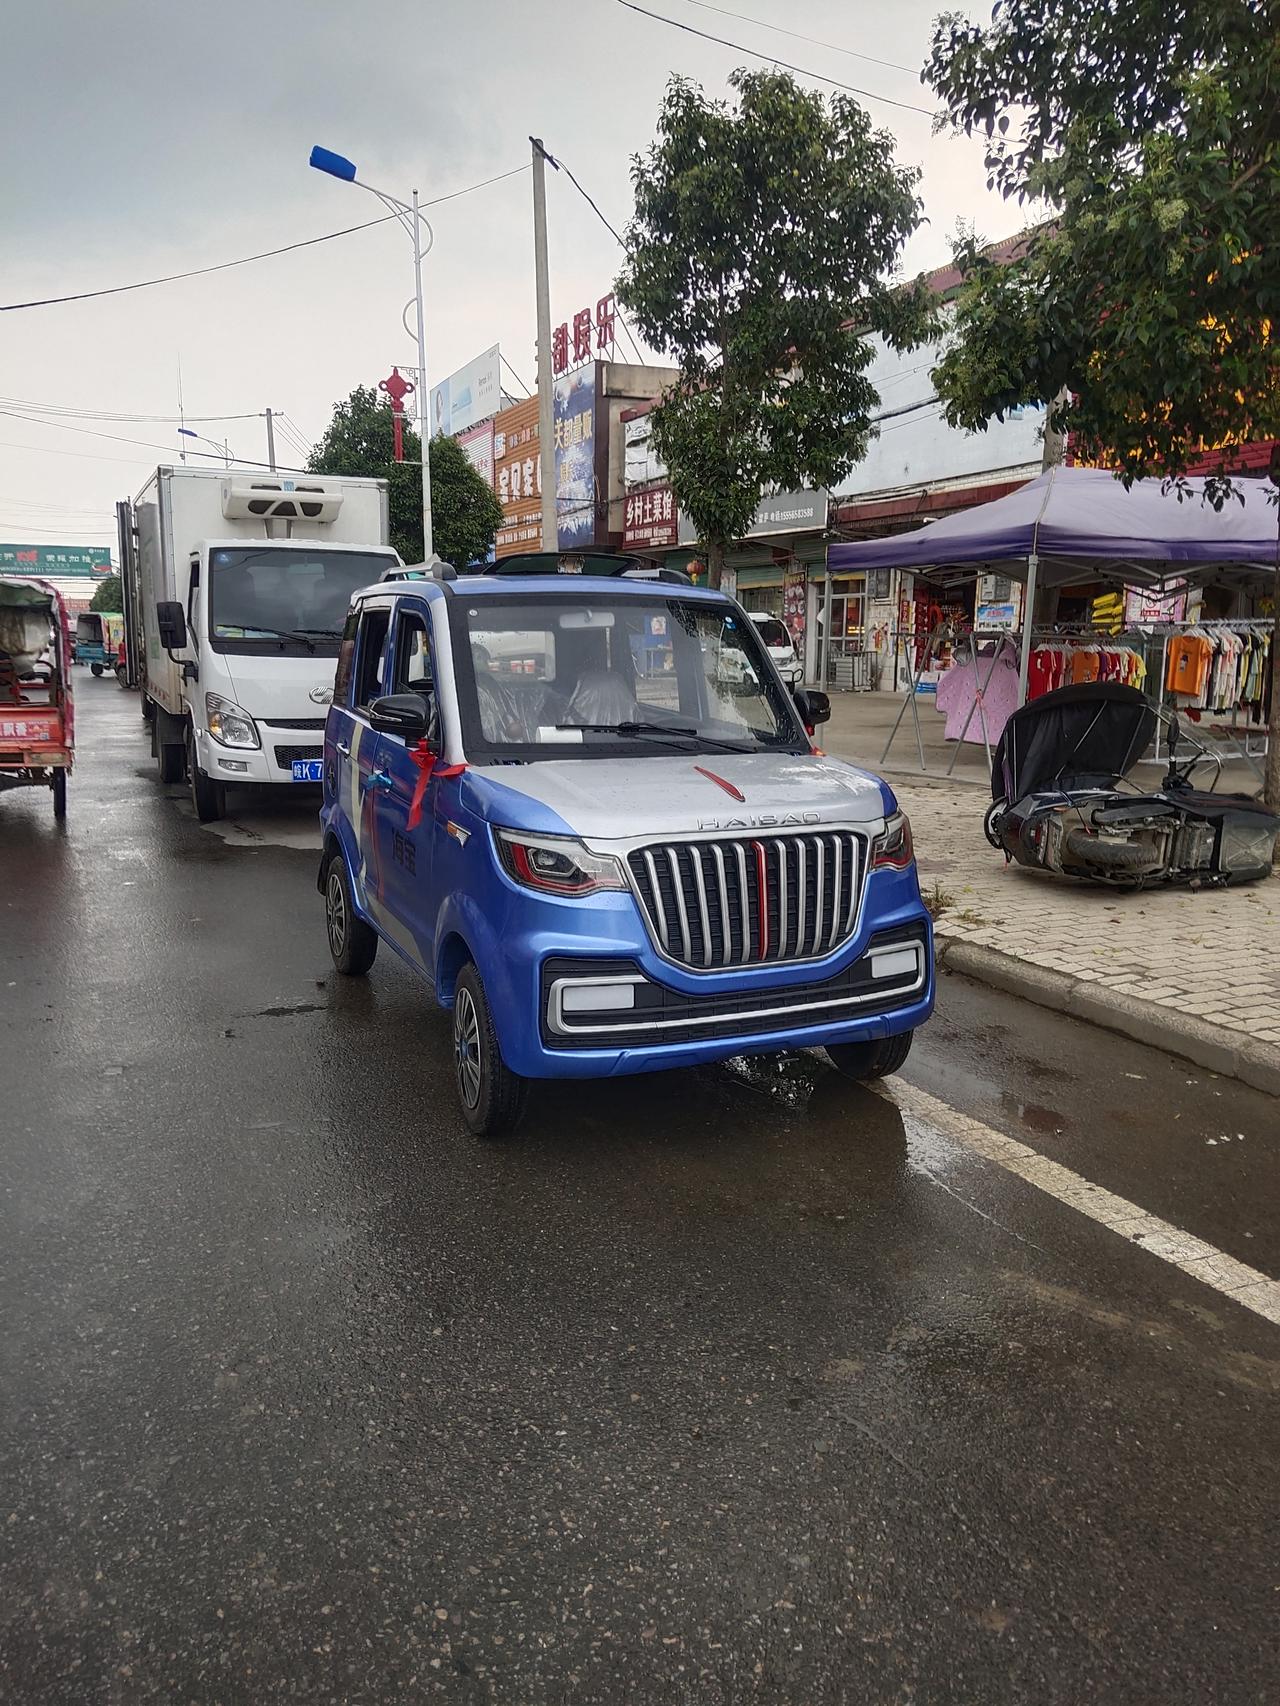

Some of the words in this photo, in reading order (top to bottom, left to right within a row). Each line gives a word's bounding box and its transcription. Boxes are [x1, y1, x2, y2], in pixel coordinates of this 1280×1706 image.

[550, 292, 615, 376] 都娱乐
[499, 453, 542, 505] 宝贝家
[625, 489, 673, 528] 乡村土菜馆
[697, 811, 820, 831] HAIBAO
